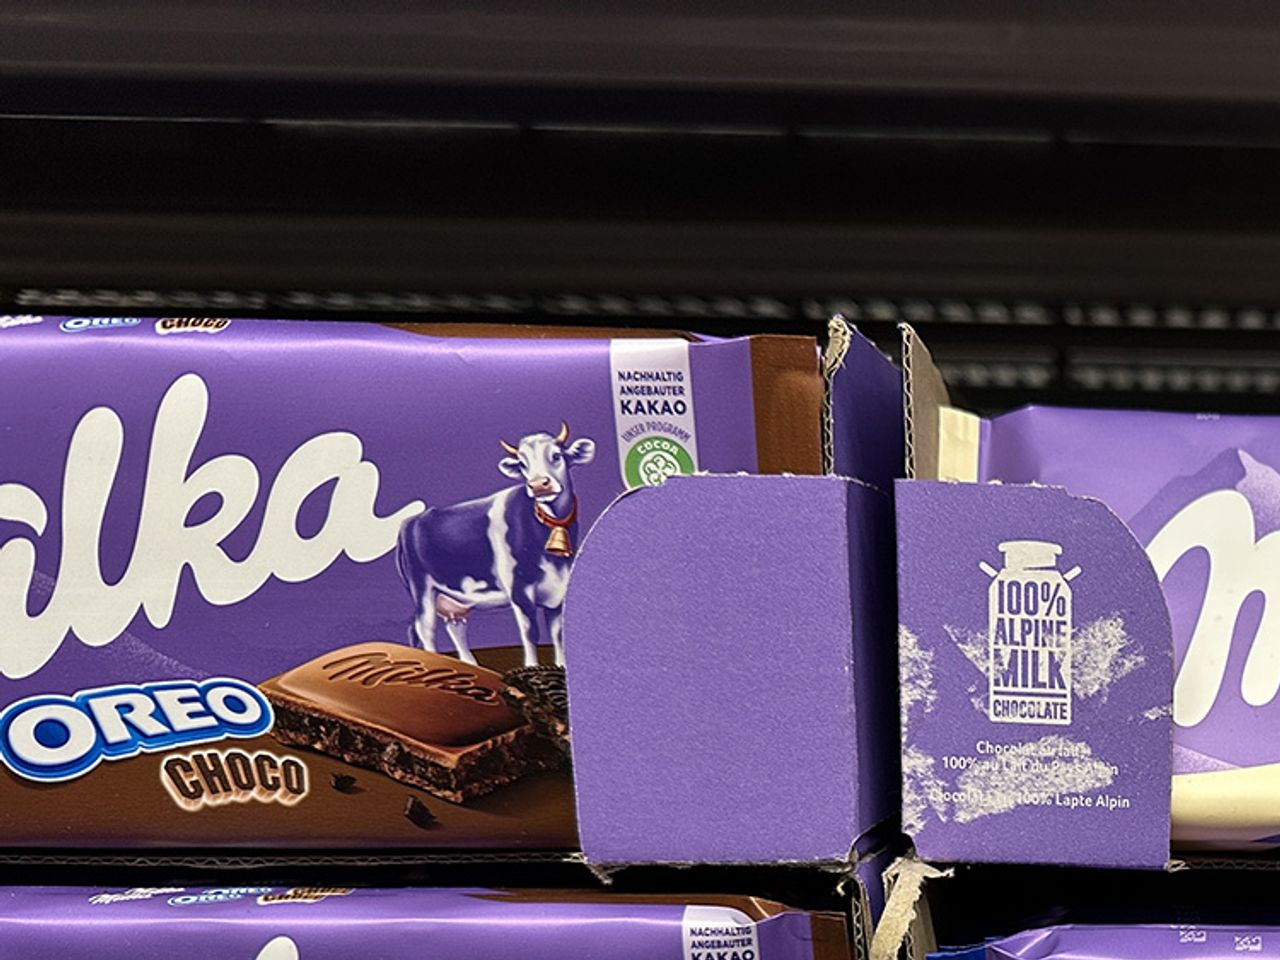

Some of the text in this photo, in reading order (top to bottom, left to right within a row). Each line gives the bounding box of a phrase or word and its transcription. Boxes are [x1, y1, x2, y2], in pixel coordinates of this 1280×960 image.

[618, 371, 684, 382] NACHHALTIG
[620, 385, 686, 396] ANGEBAUTER
[620, 399, 687, 415] KAKAO
[0, 373, 425, 680] ilka
[998, 580, 1066, 617] 100%
[994, 618, 1067, 647] ALPINE
[993, 649, 1067, 690] MILK
[993, 699, 1068, 720] CHOCOLATE
[7, 683, 264, 767] OREO
[164, 752, 307, 803] CHOCO
[1056, 794, 1131, 810] Lapte Alpin
[690, 926, 752, 937] NACHHALTIG
[691, 938, 753, 949] ANGEBAUTER
